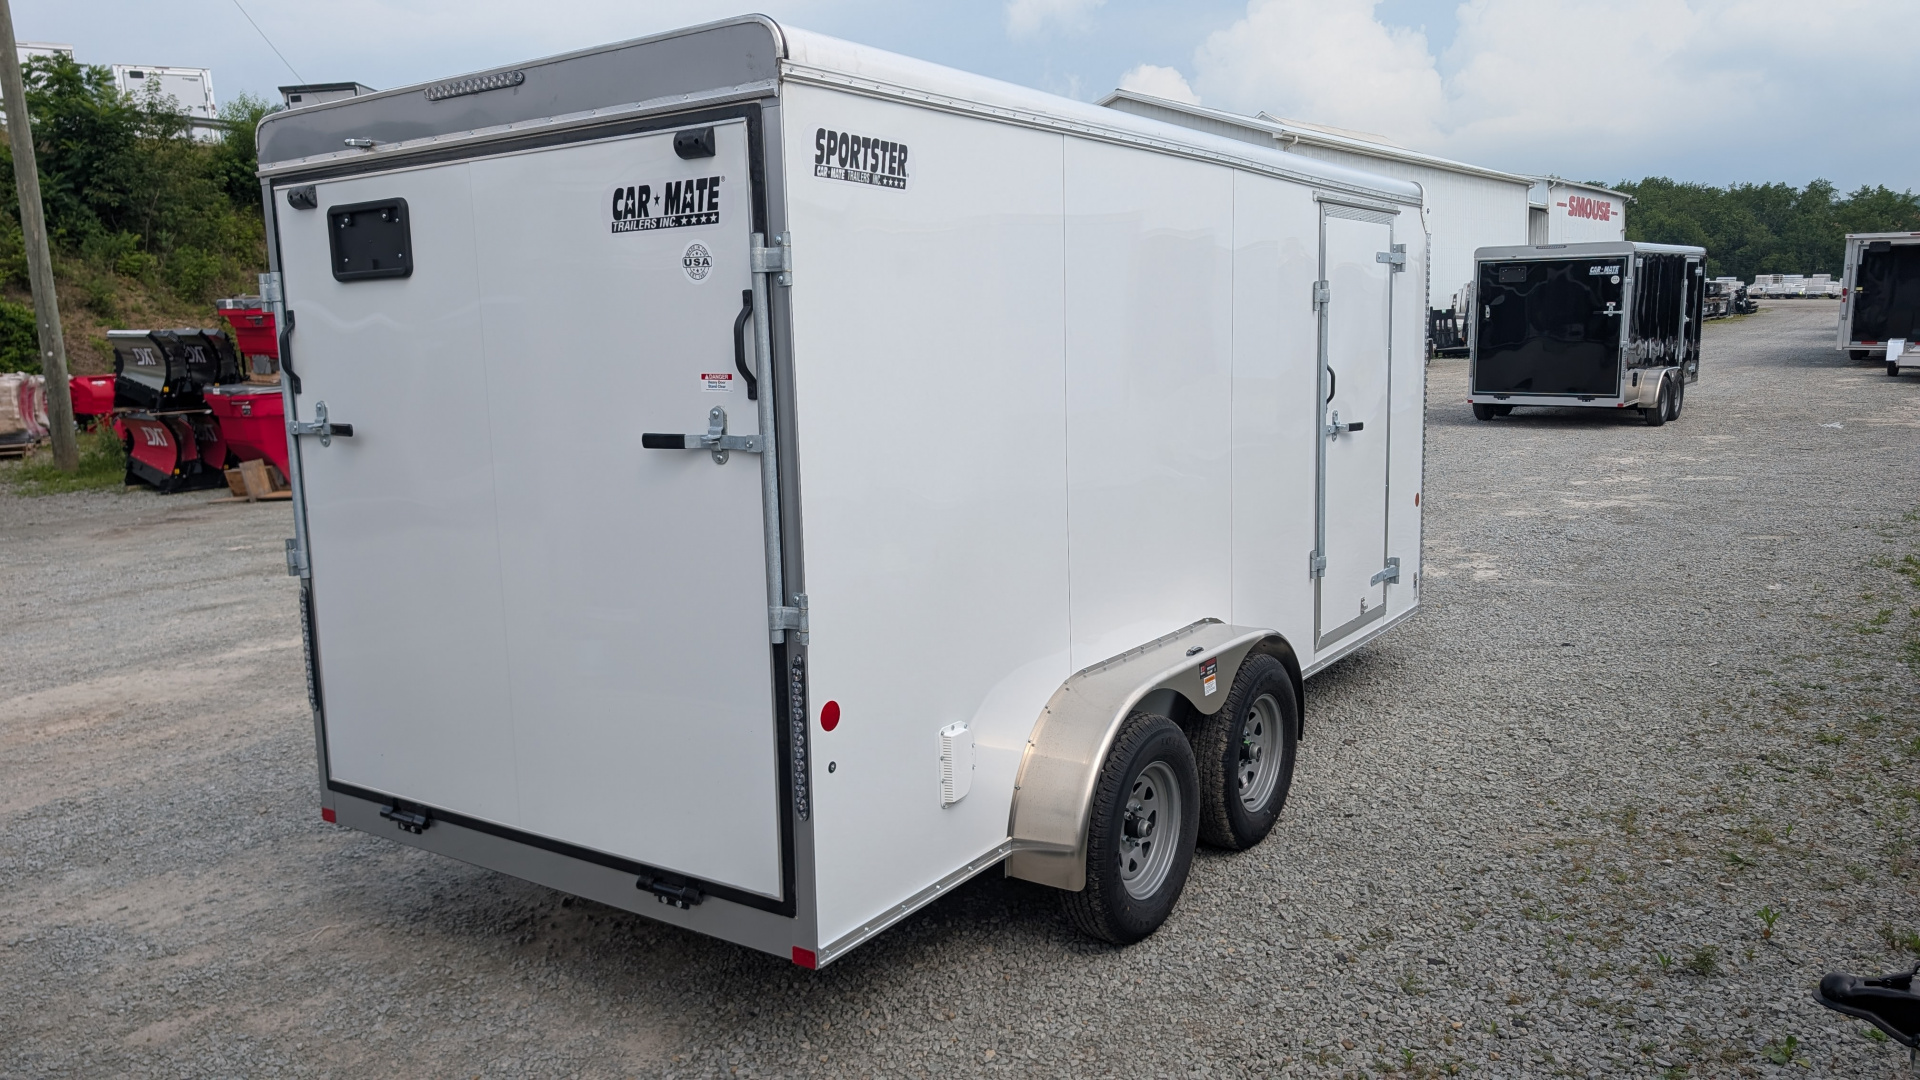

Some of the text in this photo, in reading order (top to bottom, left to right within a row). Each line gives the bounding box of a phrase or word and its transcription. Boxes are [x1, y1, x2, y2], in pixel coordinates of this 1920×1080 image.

[815, 128, 908, 177] SPORTSTER
[847, 170, 870, 184] TRAILERS
[612, 176, 720, 221] CAR MATE
[1568, 195, 1611, 221] SMOUSE
[613, 216, 679, 232] TRAILERS INC.
[684, 257, 710, 267] USA
